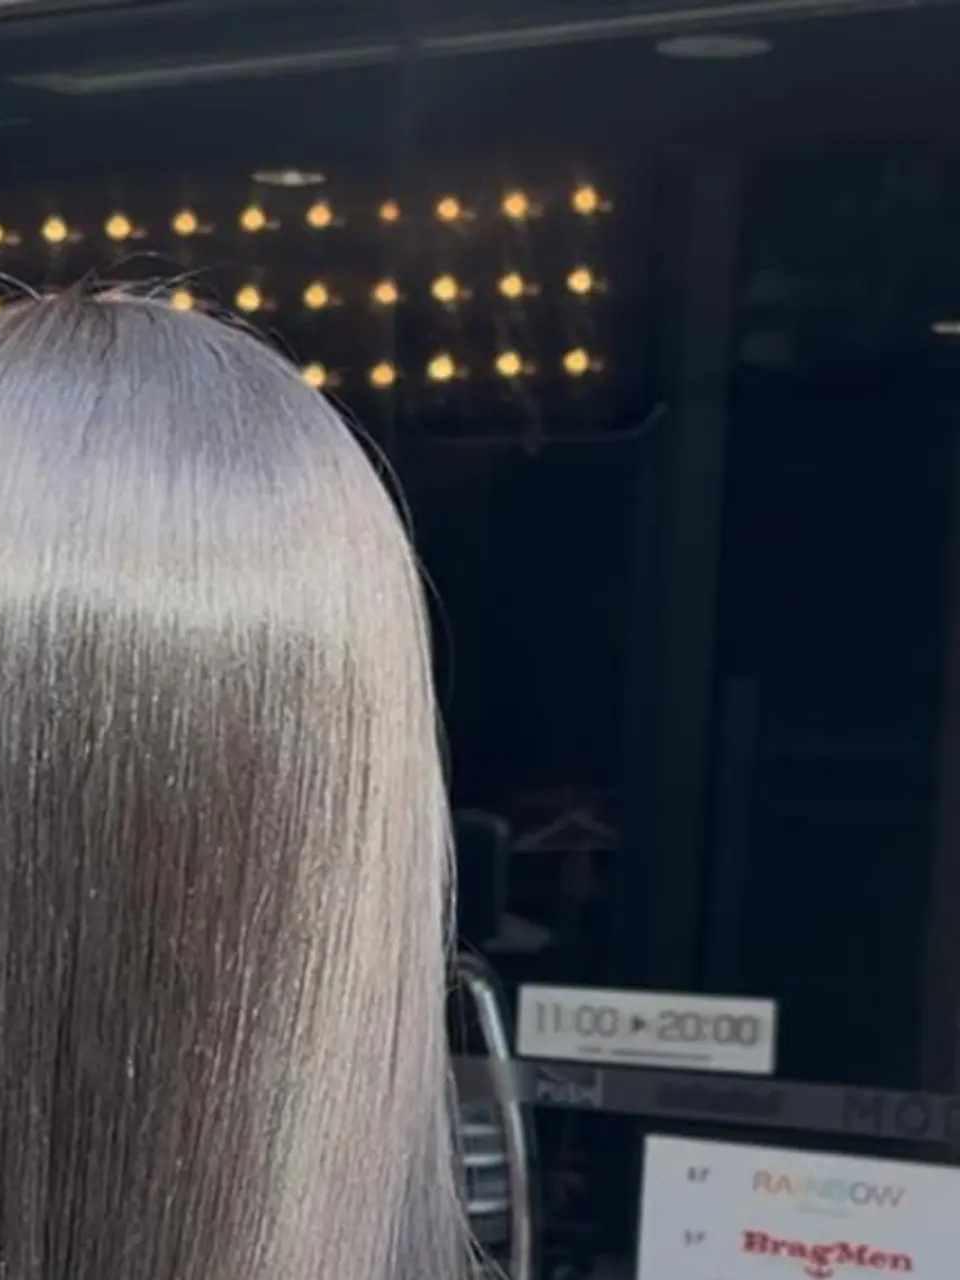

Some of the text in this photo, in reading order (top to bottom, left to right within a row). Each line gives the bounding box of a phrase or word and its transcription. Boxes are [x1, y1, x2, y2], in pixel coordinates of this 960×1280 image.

[536, 1002, 758, 1047] 11:00 20:00
[751, 1169, 906, 1208] RAINBOW
[743, 1229, 914, 1272] BragMen
